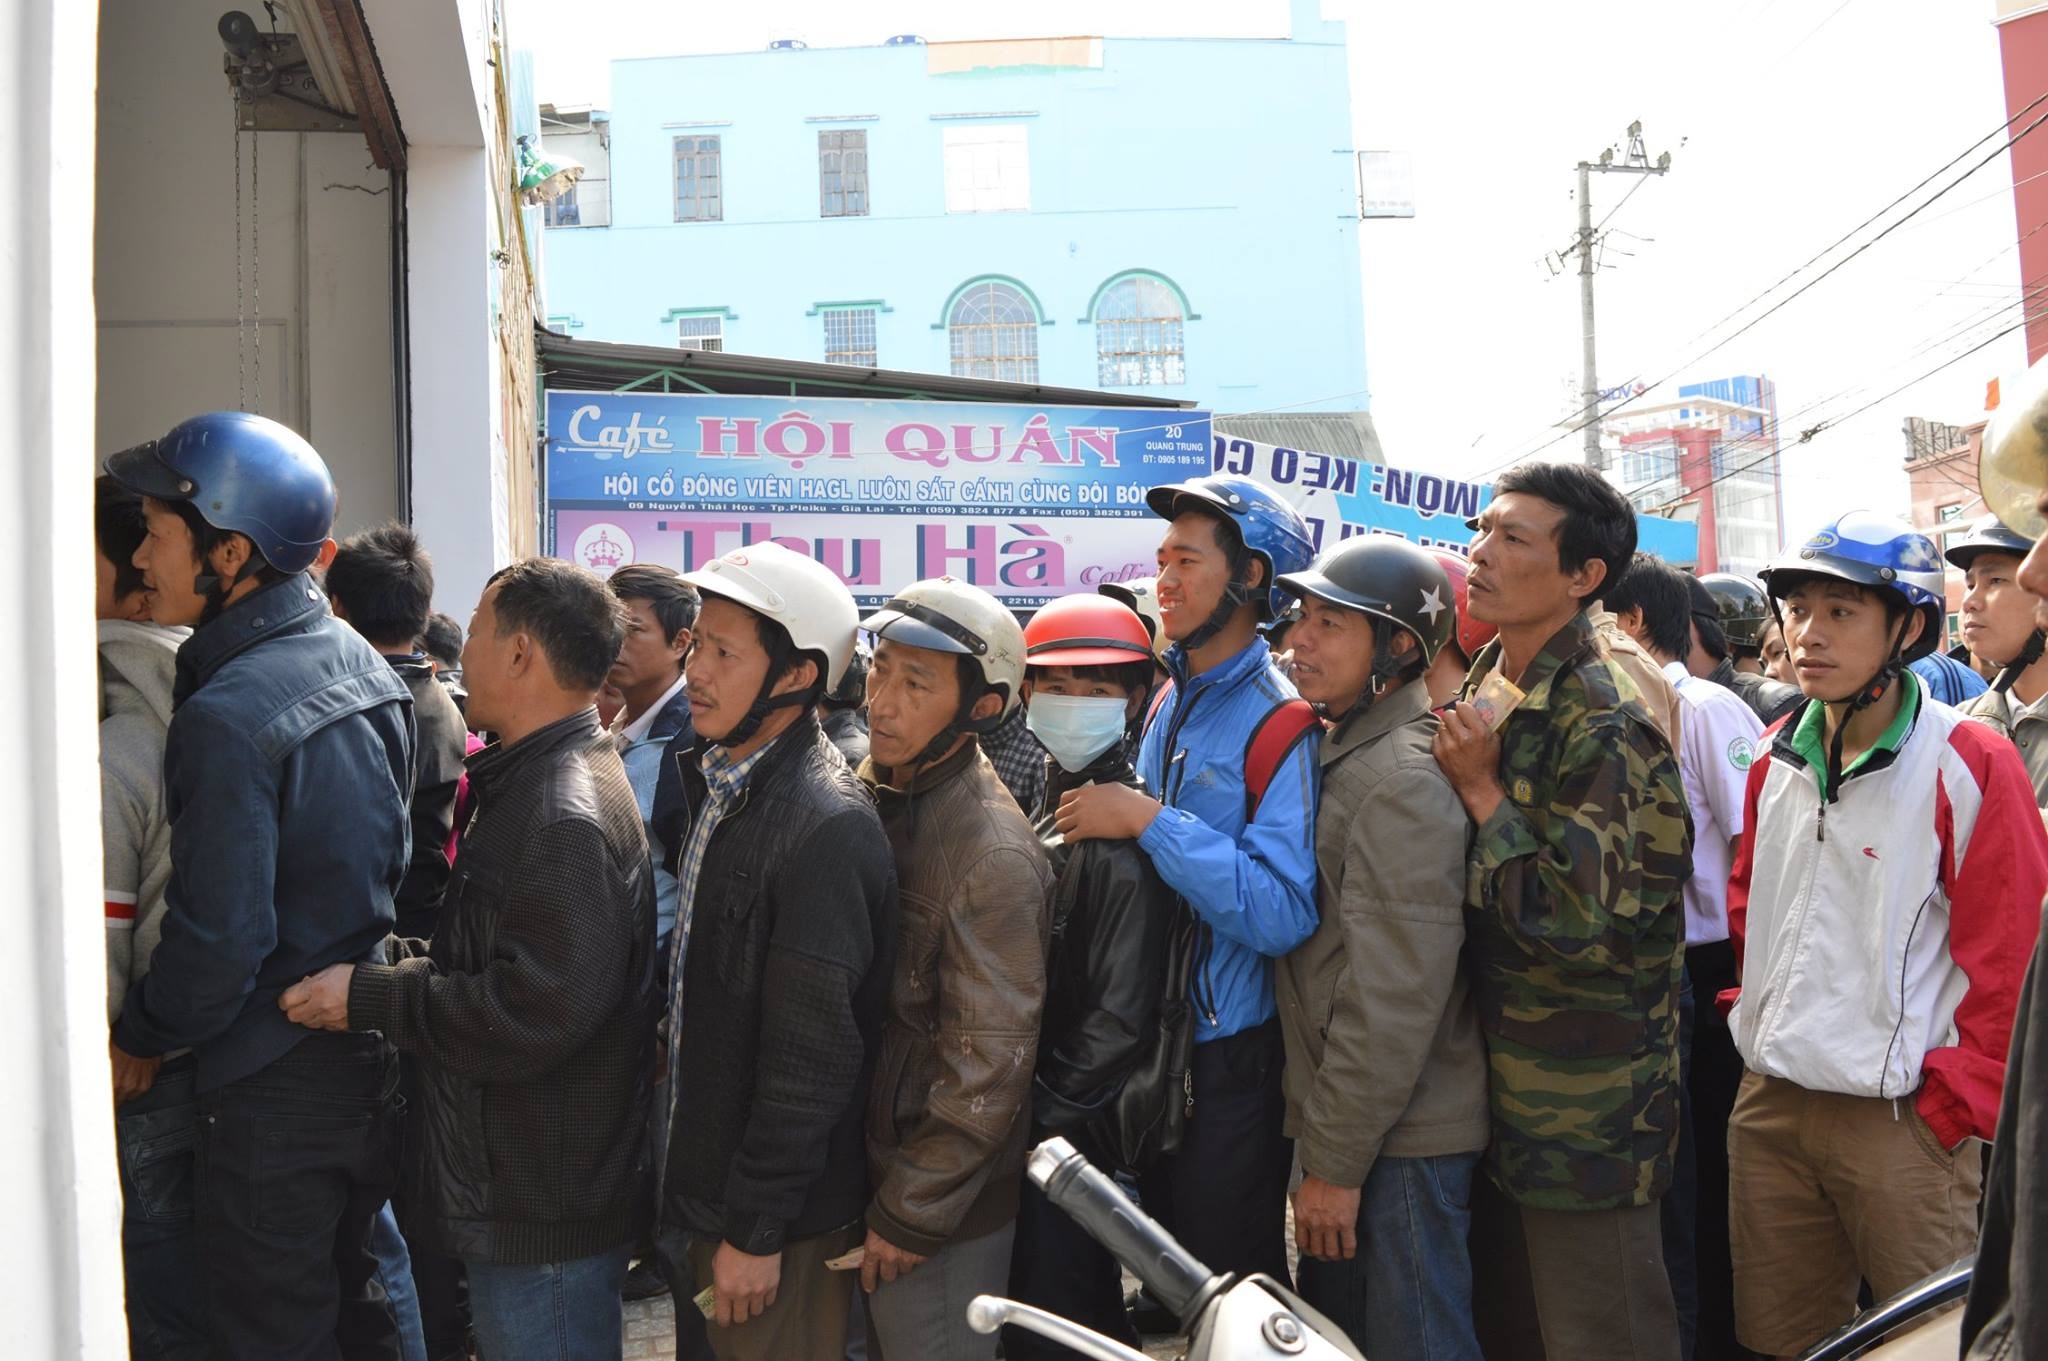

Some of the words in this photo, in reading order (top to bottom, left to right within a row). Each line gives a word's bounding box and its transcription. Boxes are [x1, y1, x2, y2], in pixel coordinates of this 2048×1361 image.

[569, 405, 673, 458] Café
[697, 411, 856, 470] HỘI
[884, 413, 1120, 468] QUÁN
[1145, 441, 1174, 451] QUANG
[1176, 442, 1204, 452] TRUNG
[1165, 425, 1182, 439] 20
[1157, 455, 1176, 464] 0905
[1177, 455, 1191, 465] 189
[1192, 456, 1206, 465] 195
[1271, 447, 1357, 496] KÉO
[604, 472, 638, 502] HỘI
[647, 469, 675, 496] CỔ
[682, 473, 738, 502] ĐỘNG
[744, 474, 793, 499] VIÊN
[801, 478, 853, 500] HAGL
[858, 475, 911, 502] LUÔN
[916, 476, 955, 502] SÁT
[960, 477, 1014, 503] CÁNH
[1019, 478, 1071, 504] CÙNG
[1078, 481, 1108, 508] ĐỘI
[1373, 465, 1480, 517] MÔN:
[648, 502, 695, 511] Nguyễn
[700, 502, 727, 511] Thái
[732, 503, 756, 512] Học
[841, 504, 861, 512] Gia
[925, 506, 956, 515] (059)
[1019, 507, 1027, 515] &
[1060, 508, 1090, 516] (059)
[916, 523, 1066, 588] Hà
[1080, 564, 1157, 585] Coff
